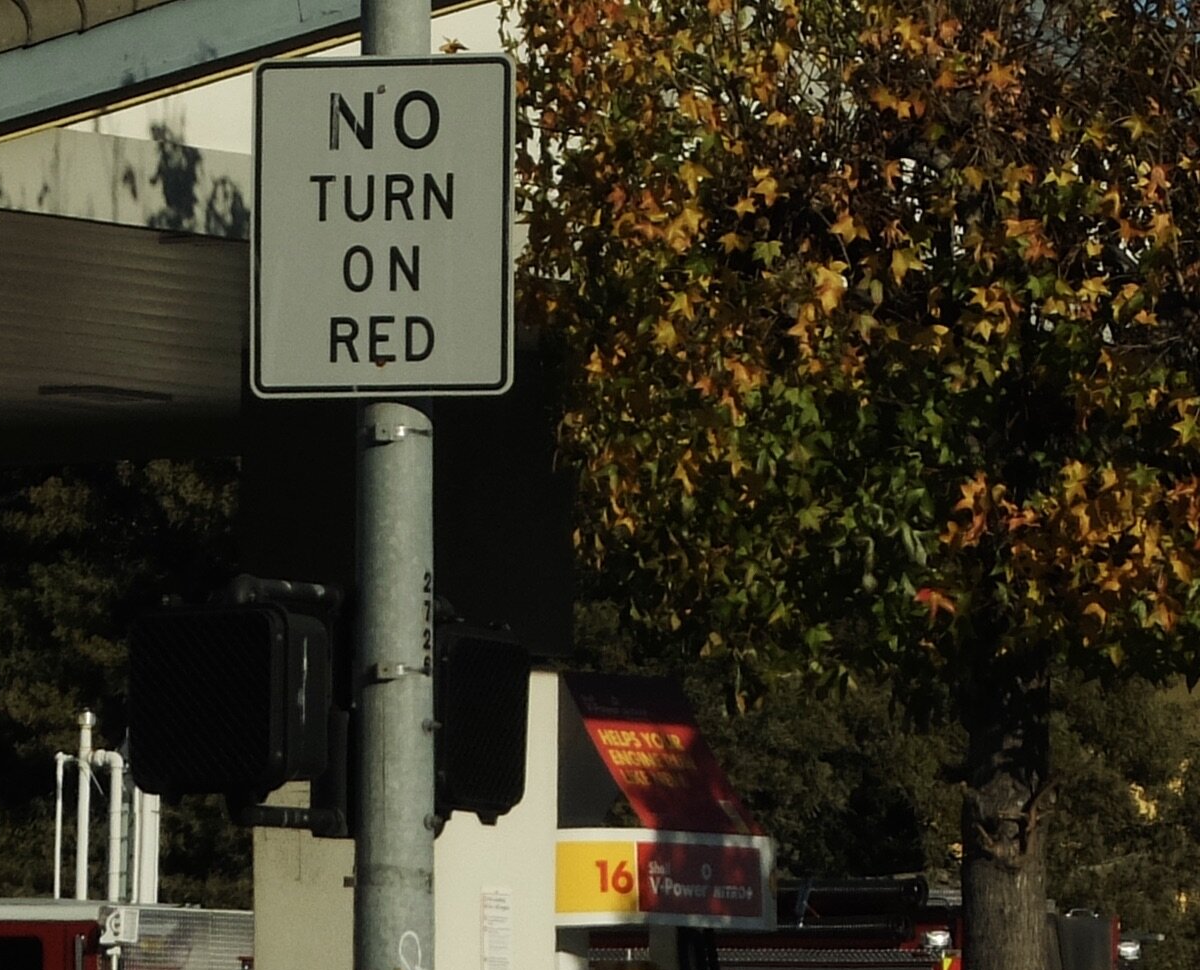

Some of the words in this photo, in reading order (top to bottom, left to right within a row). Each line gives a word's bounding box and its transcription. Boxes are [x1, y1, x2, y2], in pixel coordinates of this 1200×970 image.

[329, 90, 440, 150] NO
[309, 173, 454, 222] TURN
[343, 245, 420, 293] ON
[329, 315, 436, 363] RED
[595, 860, 633, 894] 16
